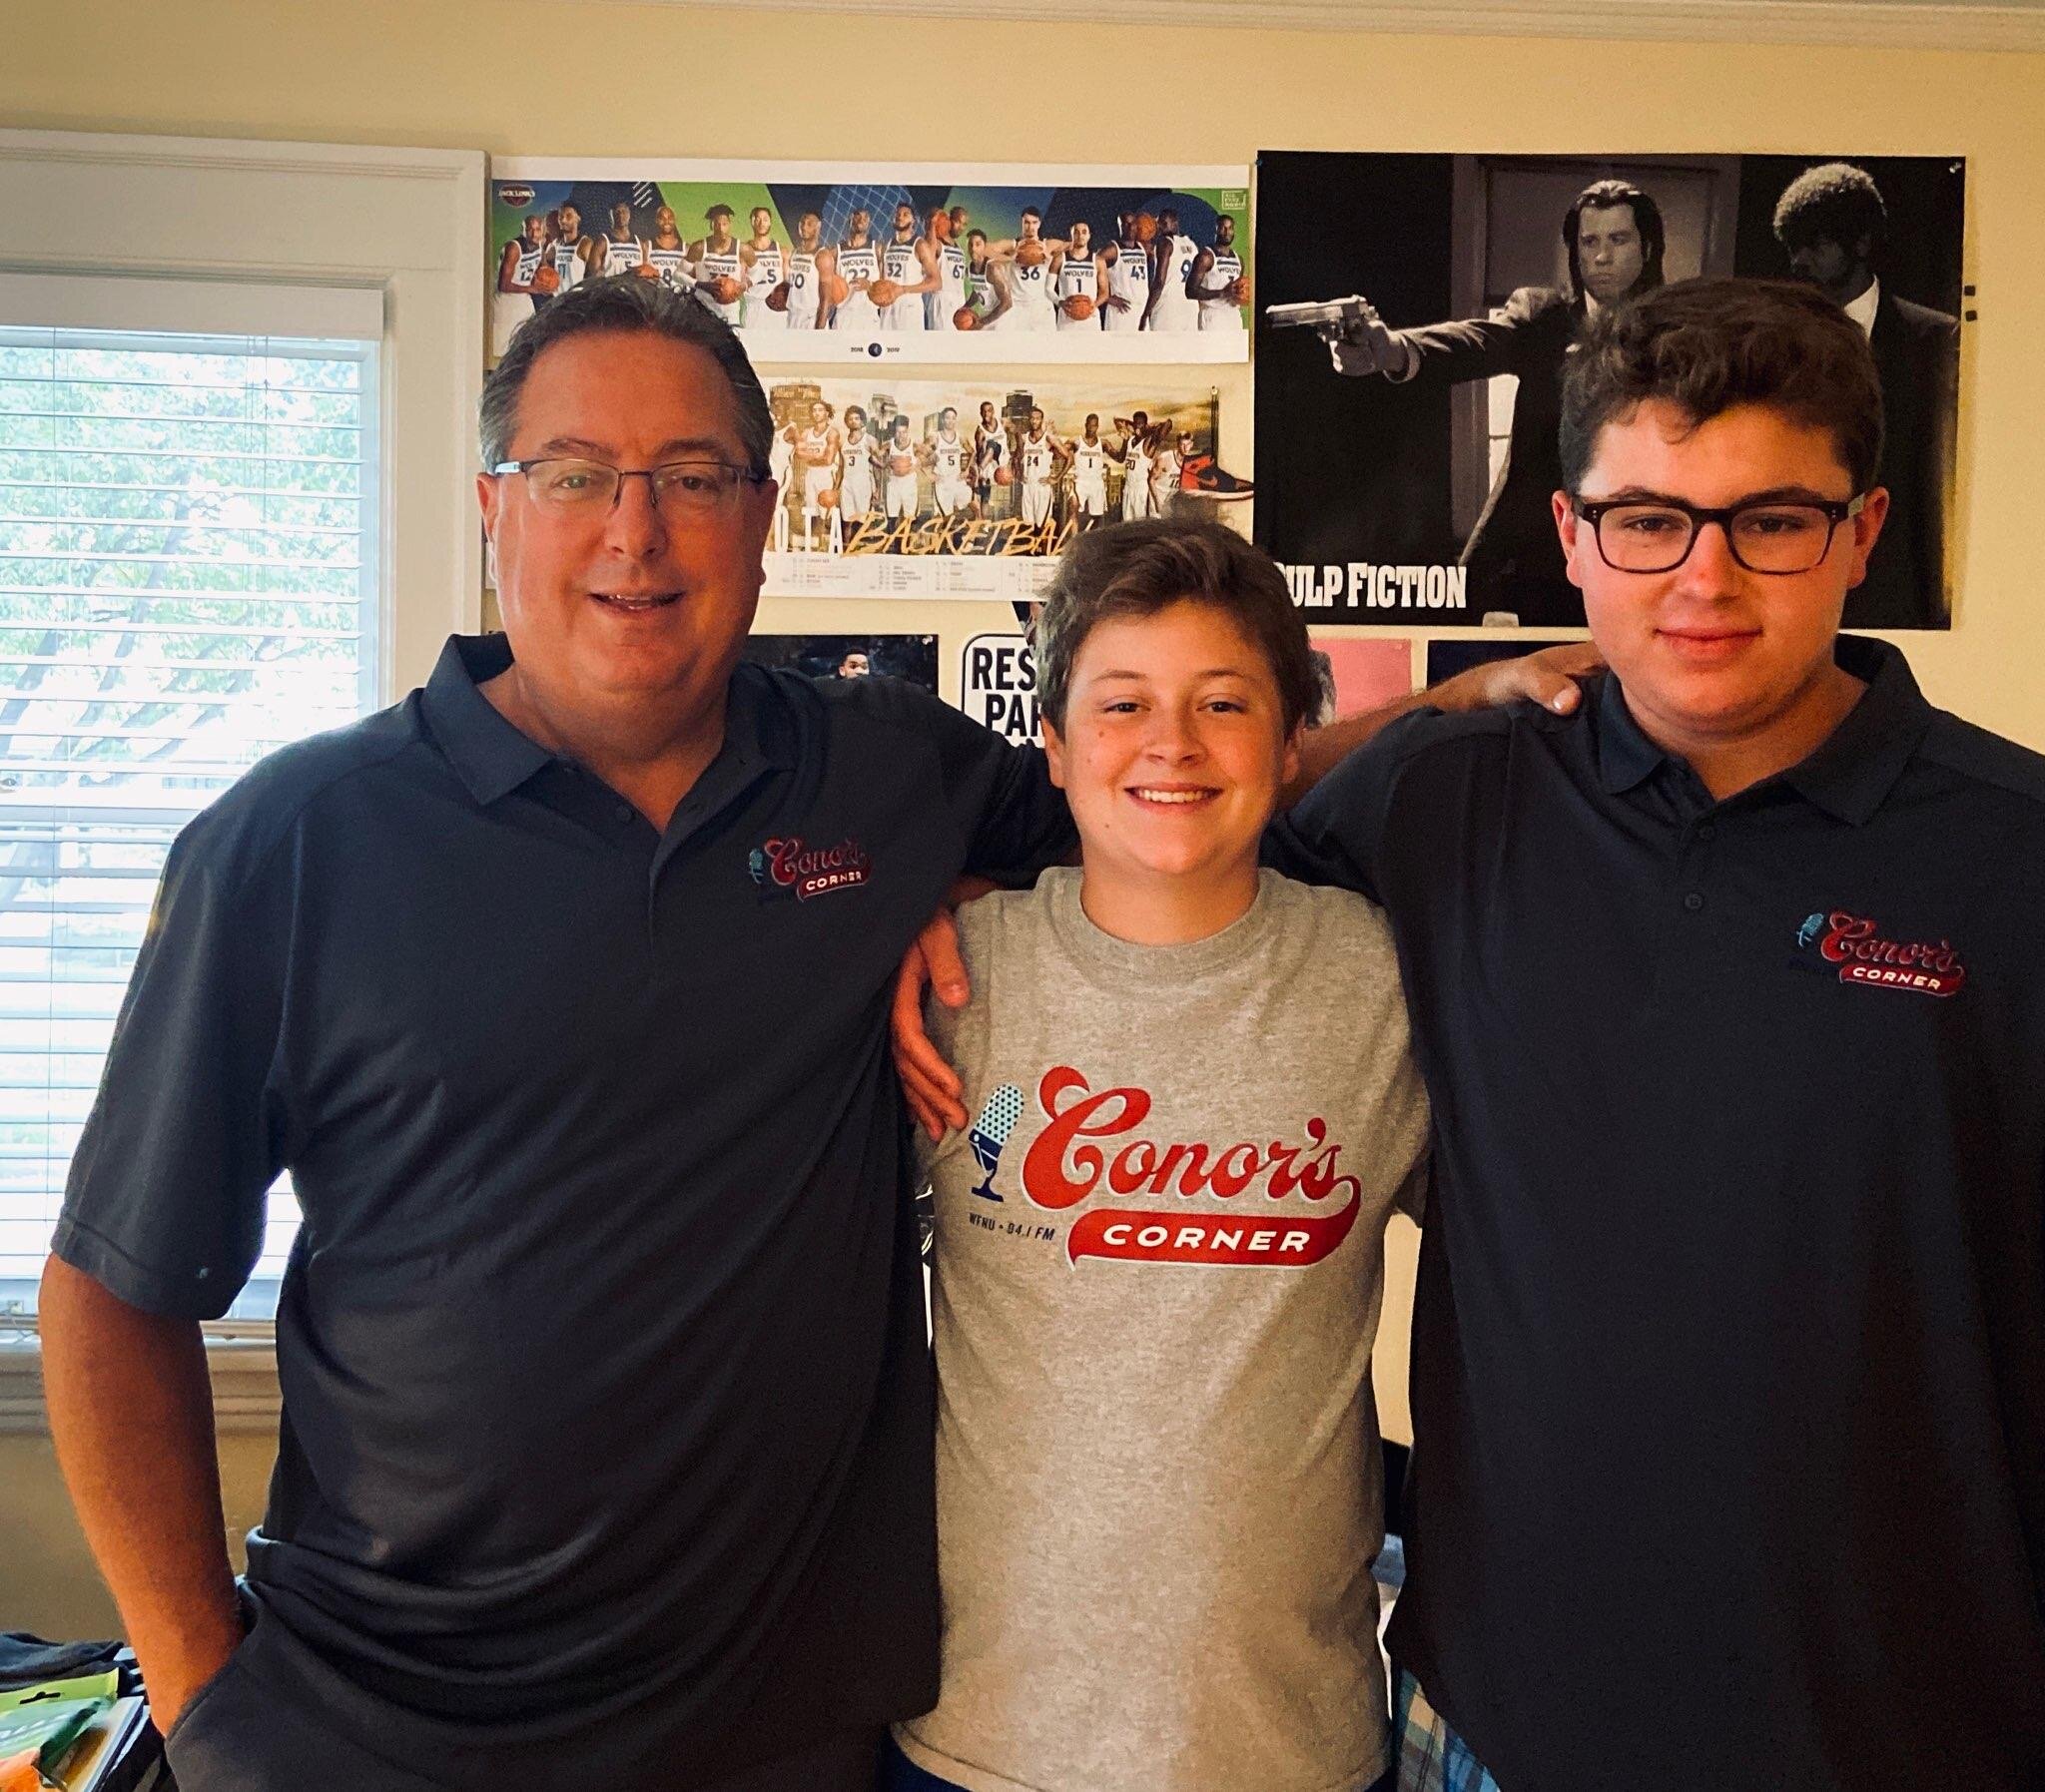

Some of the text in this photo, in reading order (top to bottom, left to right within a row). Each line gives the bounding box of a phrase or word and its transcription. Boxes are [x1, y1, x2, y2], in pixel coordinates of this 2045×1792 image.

[664, 269, 672, 284] 8
[888, 264, 902, 277] 32
[1021, 267, 1039, 280] 36
[1131, 266, 1145, 280] 43
[1180, 260, 1192, 283] 9
[1076, 279, 1081, 293] 1
[849, 456, 855, 466] 3
[949, 455, 955, 466] 5
[1088, 458, 1092, 468] 1
[1348, 562, 1466, 608] FICTION
[806, 871, 861, 891] CORNER
[1852, 966, 1941, 990] CORNER
[1022, 1065, 1344, 1209] Conor's
[970, 1212, 996, 1231] WFNU
[1035, 1226, 1055, 1241] FM
[1102, 1224, 1311, 1253] CORNER
